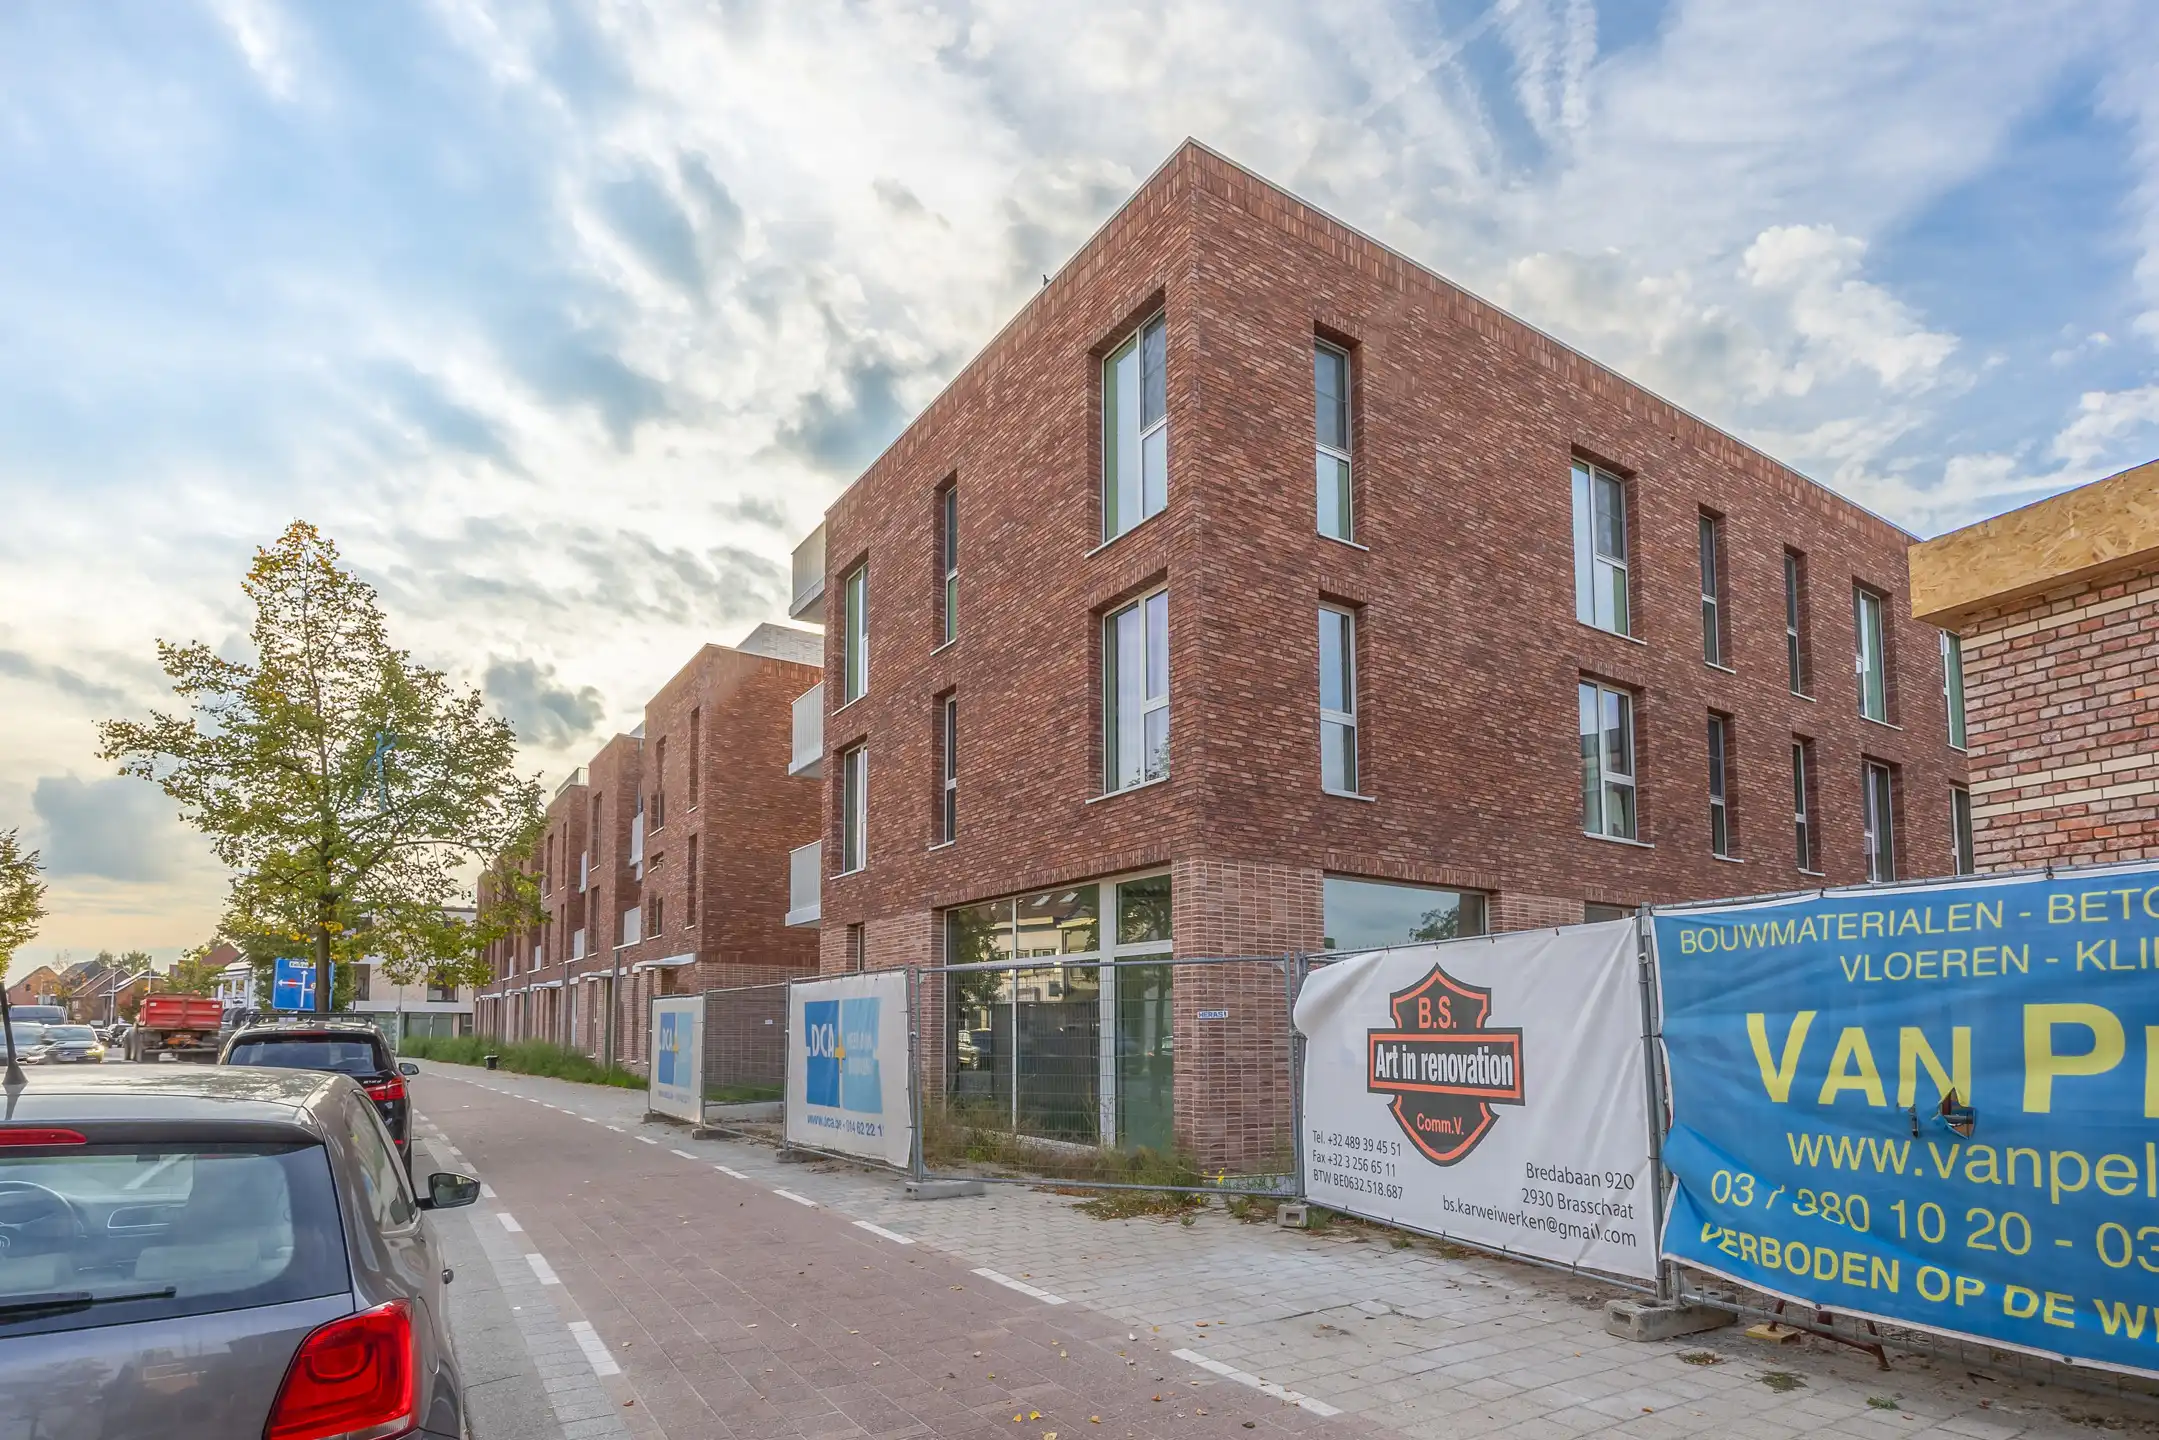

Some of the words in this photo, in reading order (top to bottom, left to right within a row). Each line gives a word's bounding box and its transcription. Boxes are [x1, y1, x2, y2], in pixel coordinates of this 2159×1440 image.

[1680, 899, 2002, 955] BOUWMATERIALEN
[1839, 944, 2029, 982] VLOEREN
[2076, 936, 2159, 971] KLI
[1418, 995, 1457, 1029] B.S.
[811, 1023, 834, 1058] DCA
[1375, 1043, 1399, 1079] Art
[1402, 1044, 1416, 1080] in
[1421, 1045, 1513, 1086] renovation
[1746, 1009, 1972, 1108] VAN
[2022, 1003, 2159, 1119] P
[857, 1121, 865, 1135] 62
[866, 1123, 876, 1137] 22
[1416, 1112, 1464, 1136] Comm.V.
[1312, 1129, 1325, 1144] Tel.
[1328, 1133, 1342, 1147] +32
[1345, 1135, 1360, 1150] 489
[1363, 1137, 1374, 1152] 39
[1376, 1139, 1388, 1154] 45
[1390, 1142, 1401, 1157] 51
[1312, 1149, 1325, 1163] Fax
[1328, 1153, 1342, 1167] +32
[1345, 1155, 1350, 1169] 3
[1353, 1156, 1368, 1172] 256
[1371, 1160, 1382, 1175] 65
[1386, 1162, 1396, 1177] 11
[1526, 1162, 1601, 1188] Bredabaan
[1605, 1171, 1635, 1191] 920
[1787, 1131, 2157, 1205] www.vanpel
[1313, 1168, 1332, 1184] BTW
[1334, 1173, 1403, 1200] BE0632.518.687
[1443, 1194, 1637, 1247] bs.karweiwerken@gmail.com
[1521, 1188, 1554, 1208] 2930
[1557, 1192, 1634, 1220] Brasschaat
[1711, 1169, 1756, 1207] 03
[1792, 1188, 1870, 1232] 380
[1890, 1199, 1946, 1243] 10
[1966, 1207, 2032, 1256] 20
[1701, 1222, 1899, 1294] VERBODEN
[1916, 1265, 1986, 1307] OP
[2003, 1284, 2075, 1329] DE
